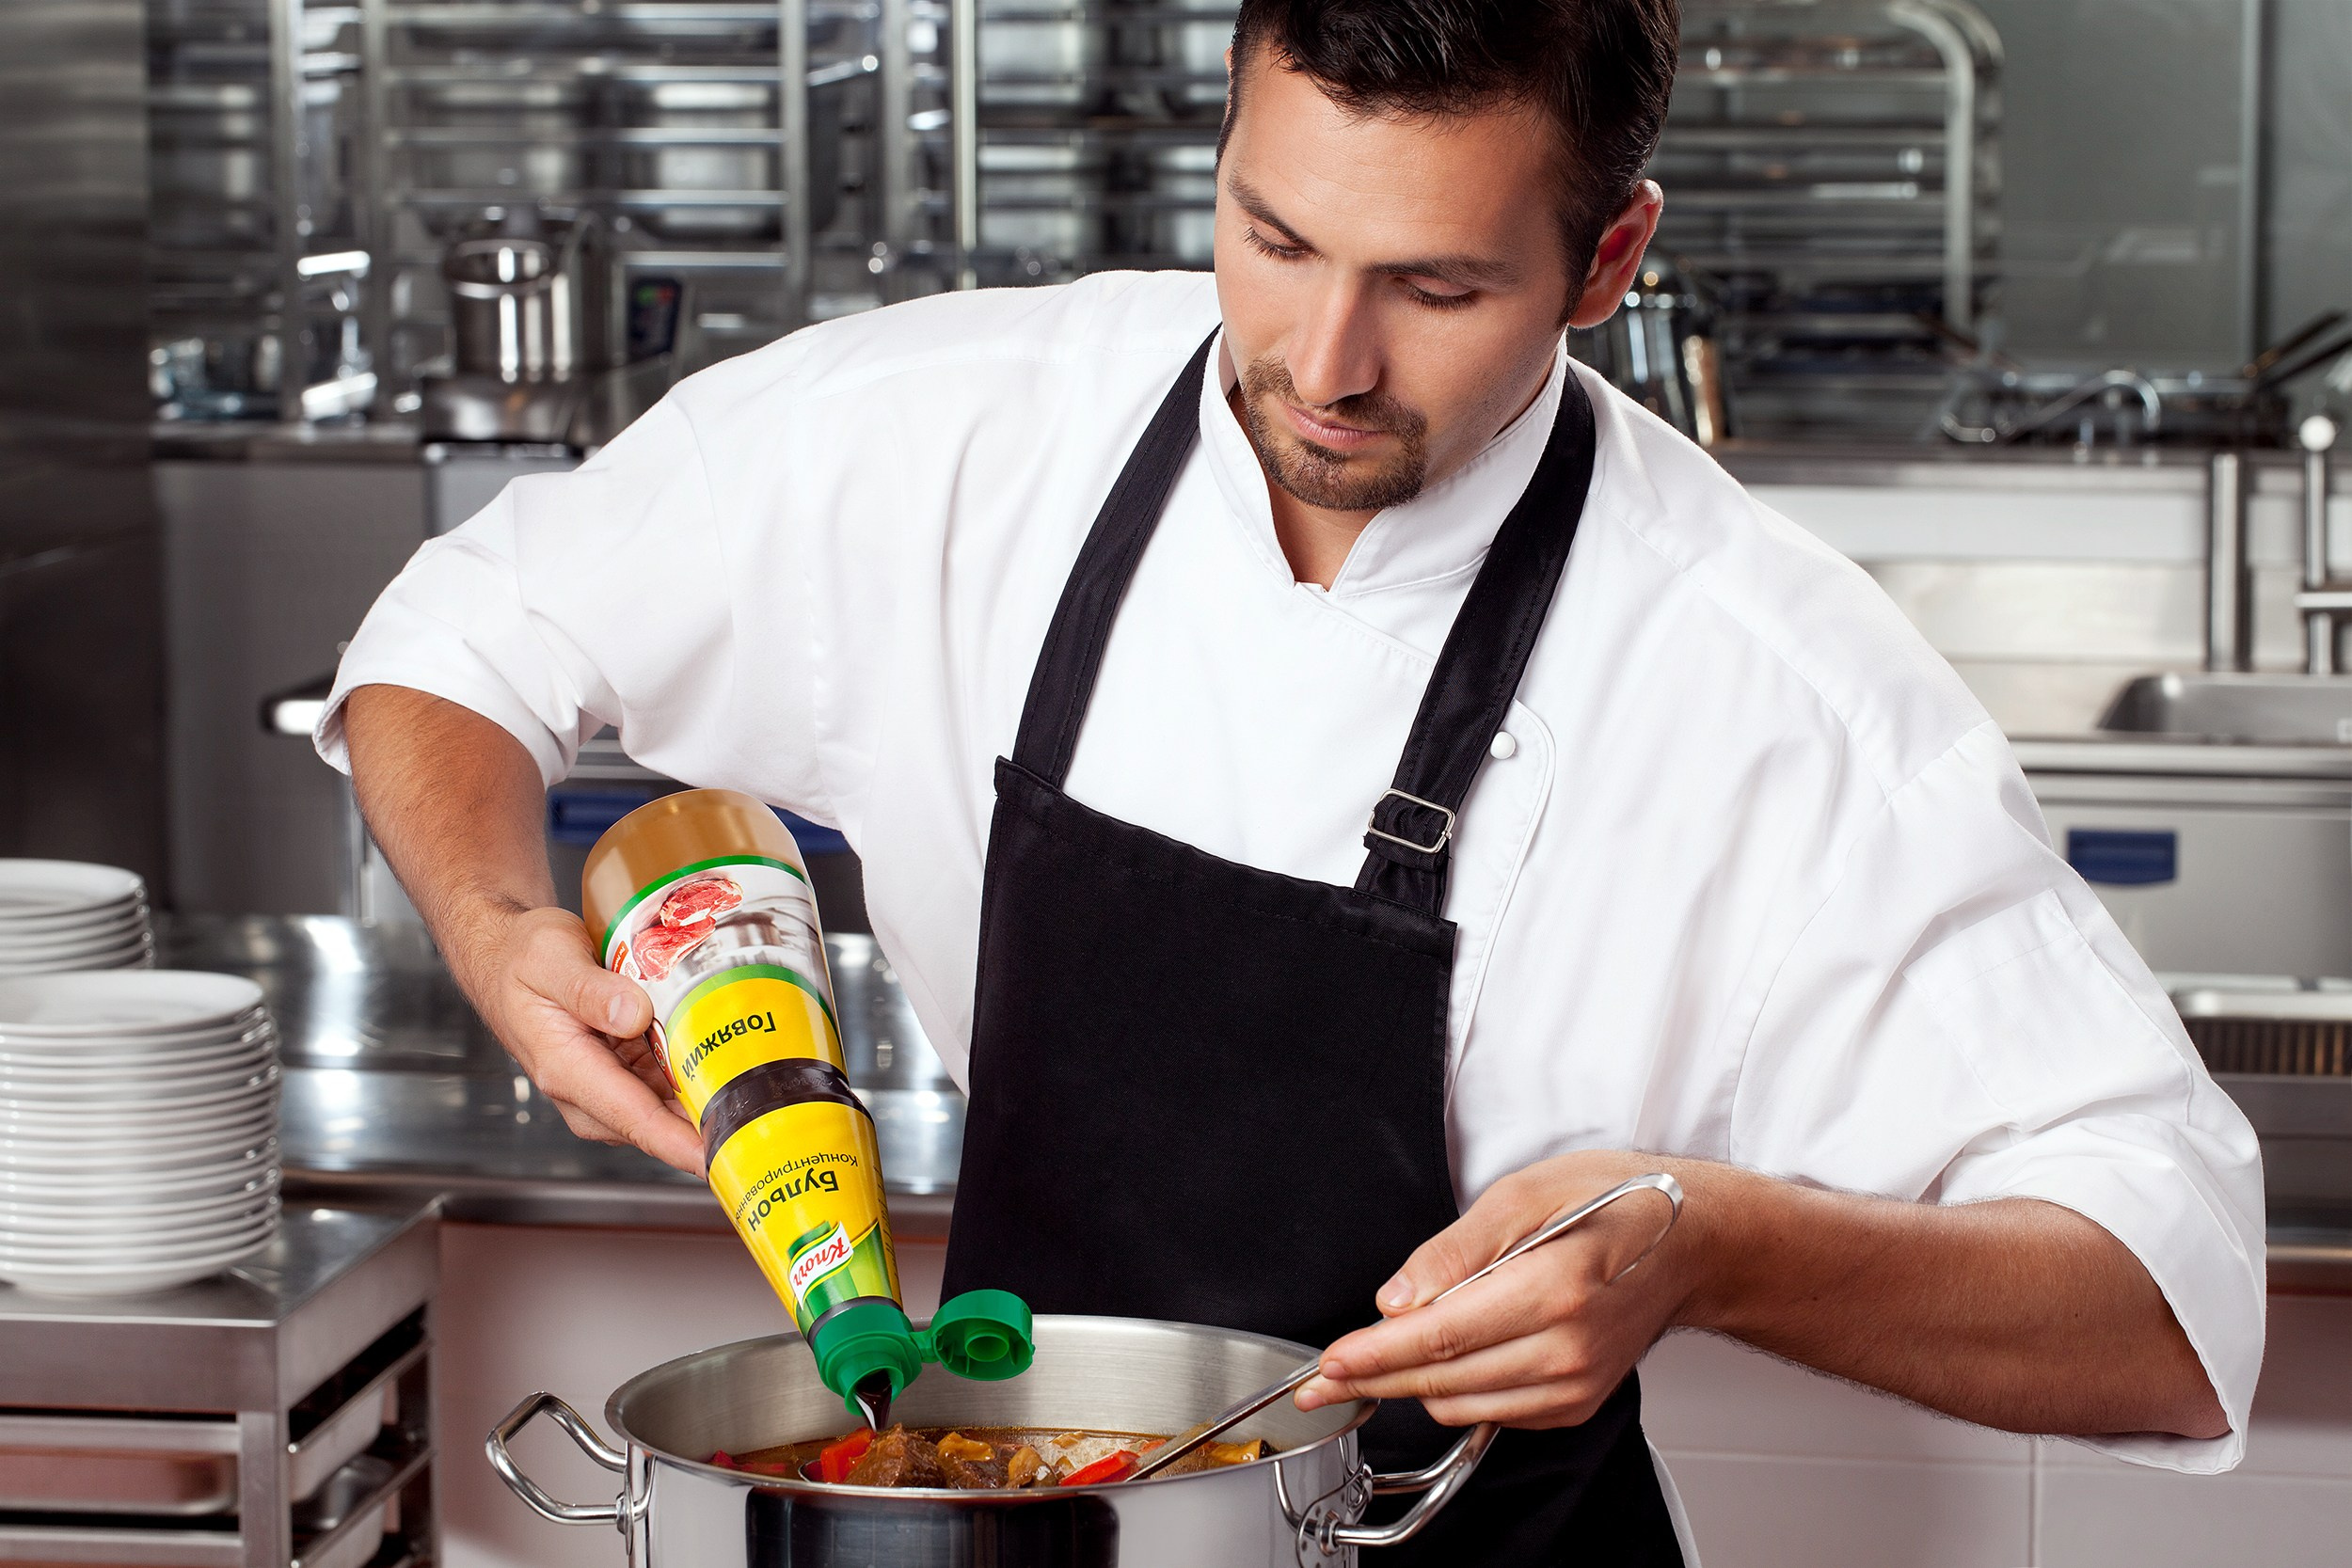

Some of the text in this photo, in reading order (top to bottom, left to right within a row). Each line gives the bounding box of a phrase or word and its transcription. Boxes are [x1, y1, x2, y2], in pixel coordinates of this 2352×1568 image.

[681, 1011, 776, 1082] Говяжий
[747, 1167, 839, 1232] Бульон
[793, 1237, 850, 1287] Knorr
